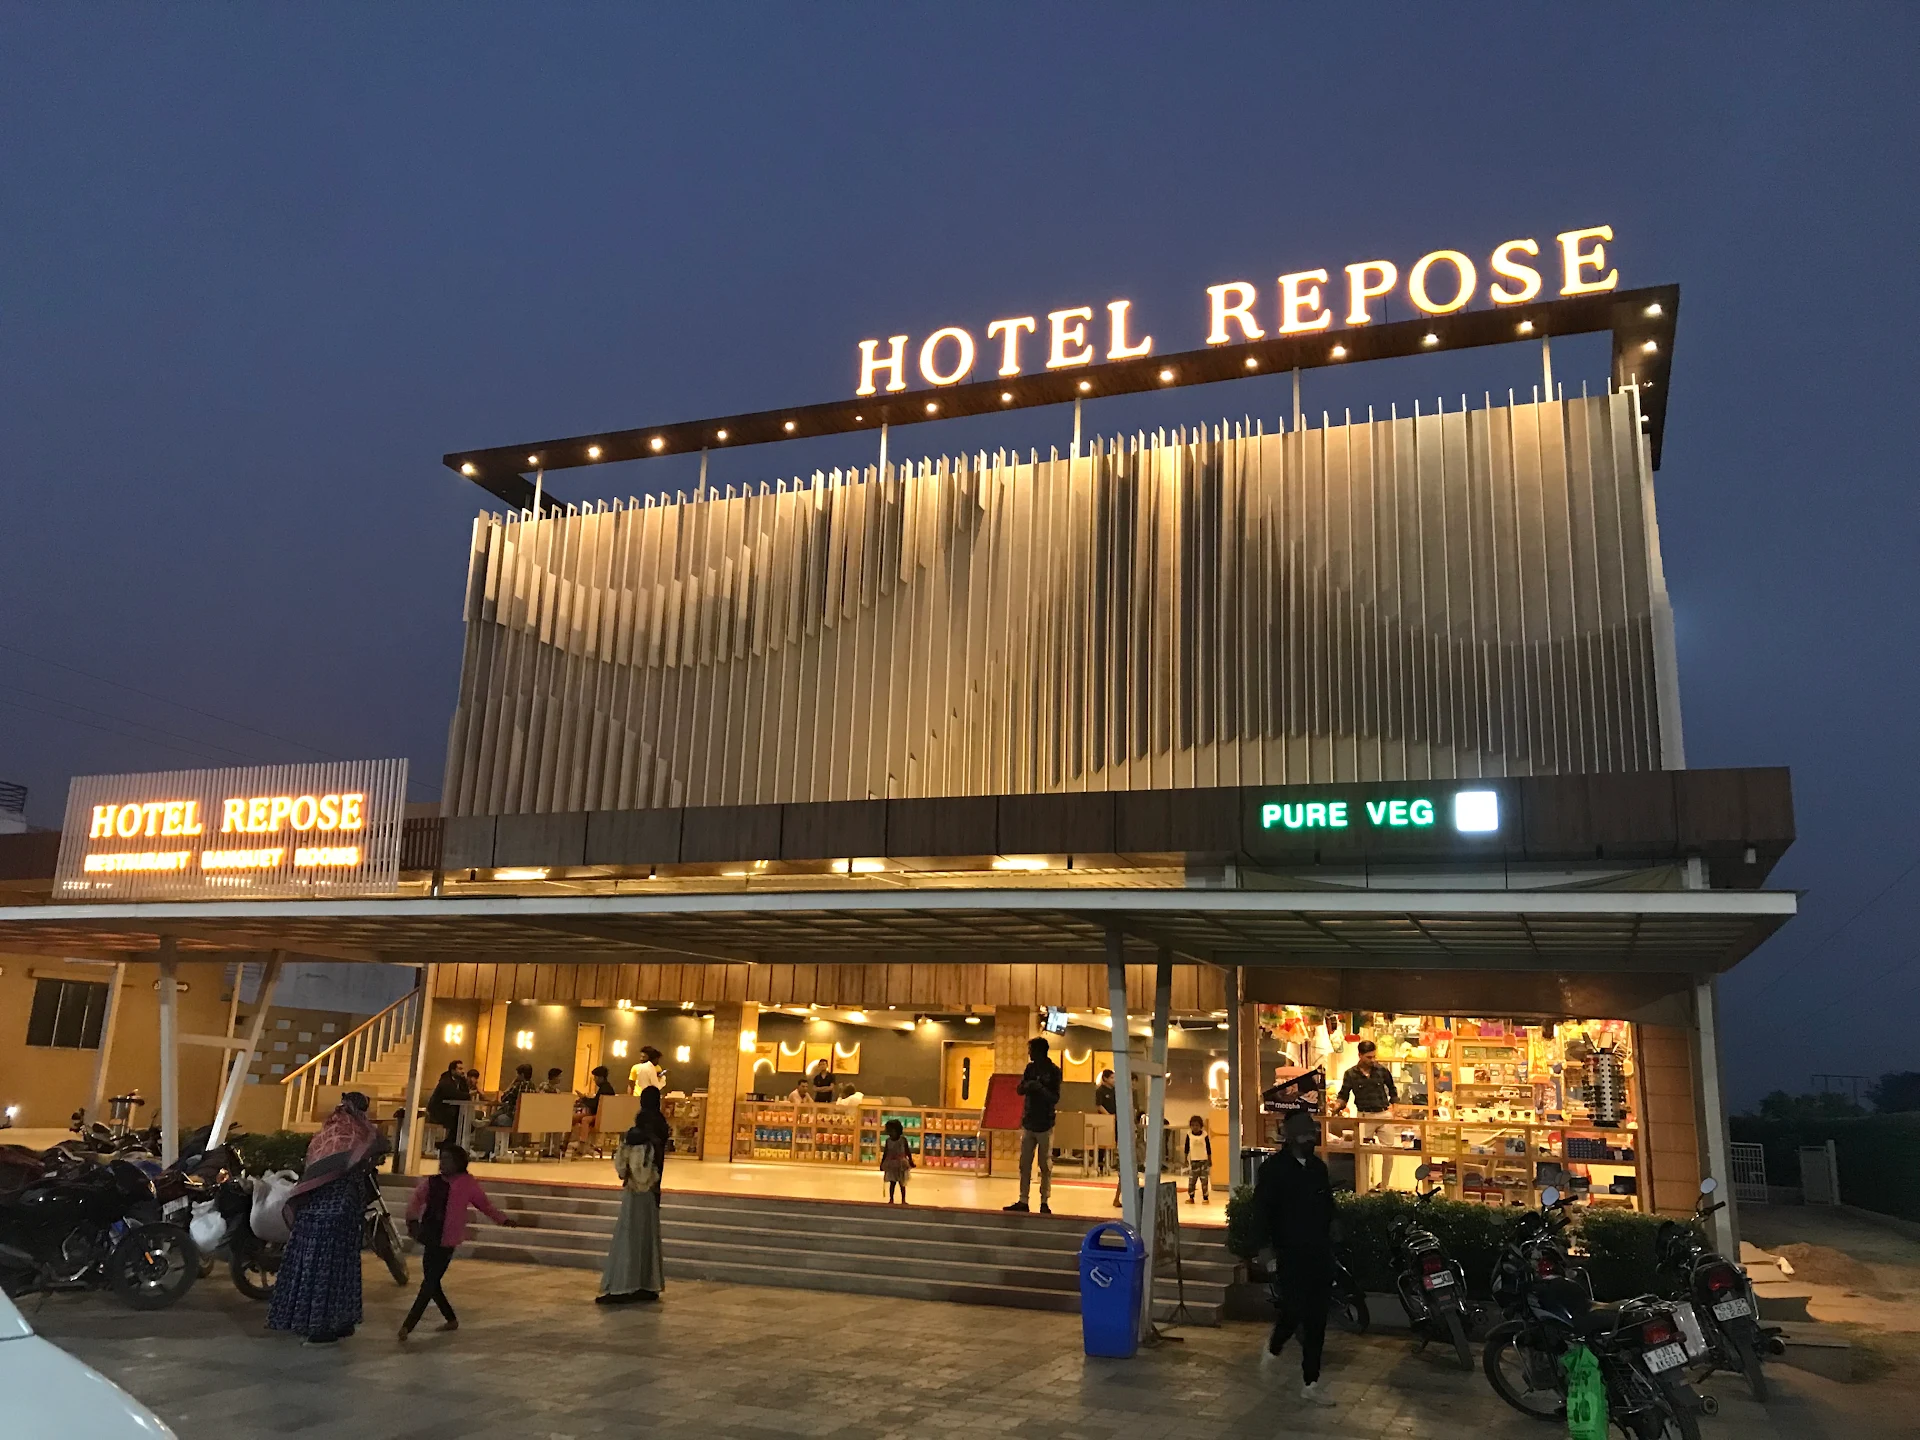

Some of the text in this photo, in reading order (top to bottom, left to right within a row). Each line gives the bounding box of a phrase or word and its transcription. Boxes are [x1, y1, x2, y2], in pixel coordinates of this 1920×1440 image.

[856, 224, 1620, 397] HOTEL REPOSE
[89, 793, 365, 839] HOTEL REPOSE
[1262, 799, 1435, 829] PURE VEG
[201, 848, 283, 870] BANQUET
[295, 846, 362, 868] ROOMS
